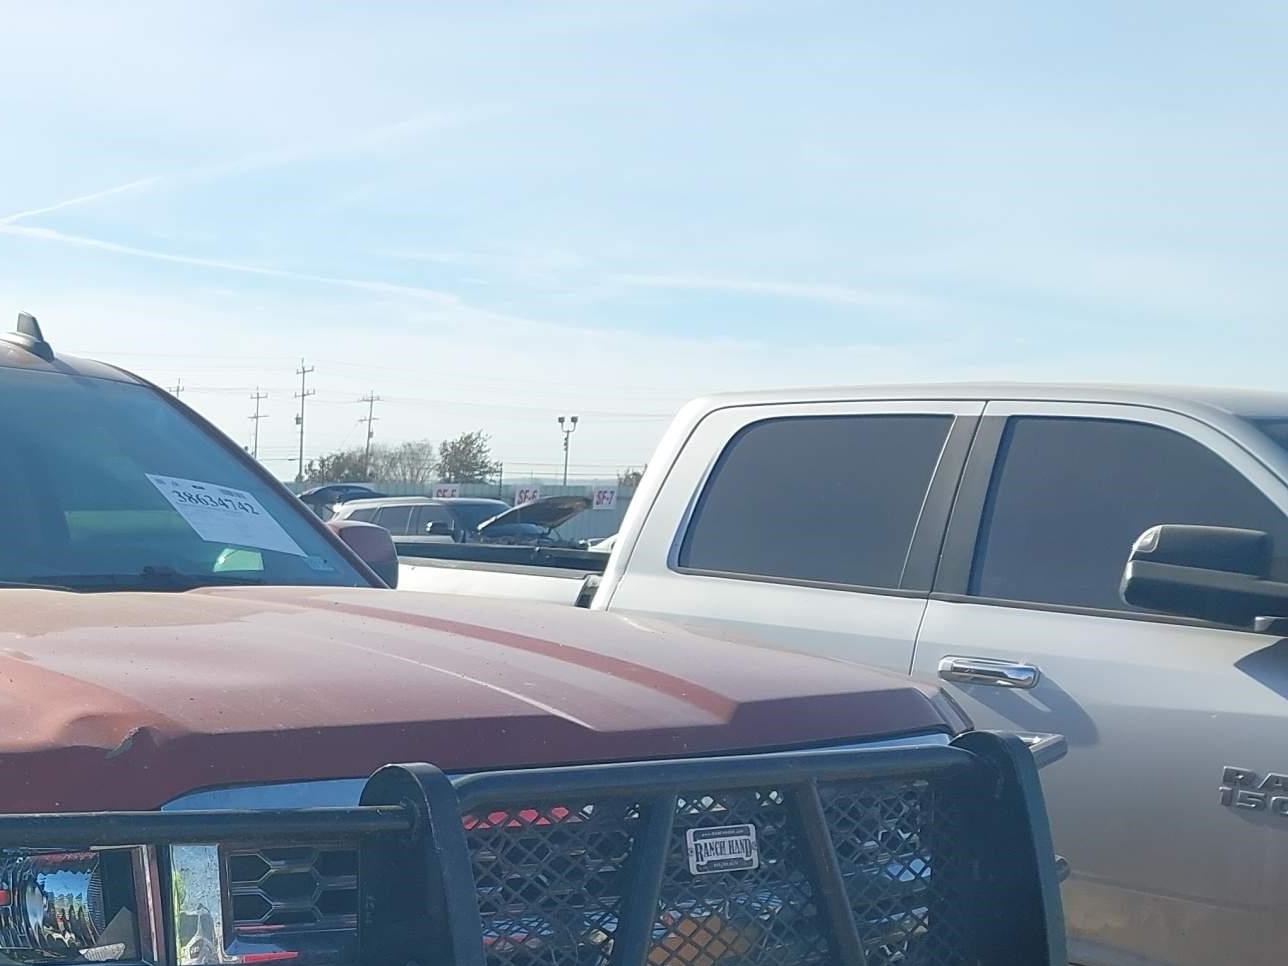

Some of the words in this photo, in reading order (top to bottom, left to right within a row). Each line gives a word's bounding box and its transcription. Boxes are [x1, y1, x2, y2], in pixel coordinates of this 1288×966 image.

[171, 490, 260, 515] 38634742
[596, 490, 615, 505] SF-7
[694, 840, 727, 862] RANCH
[728, 839, 753, 858] HAND
